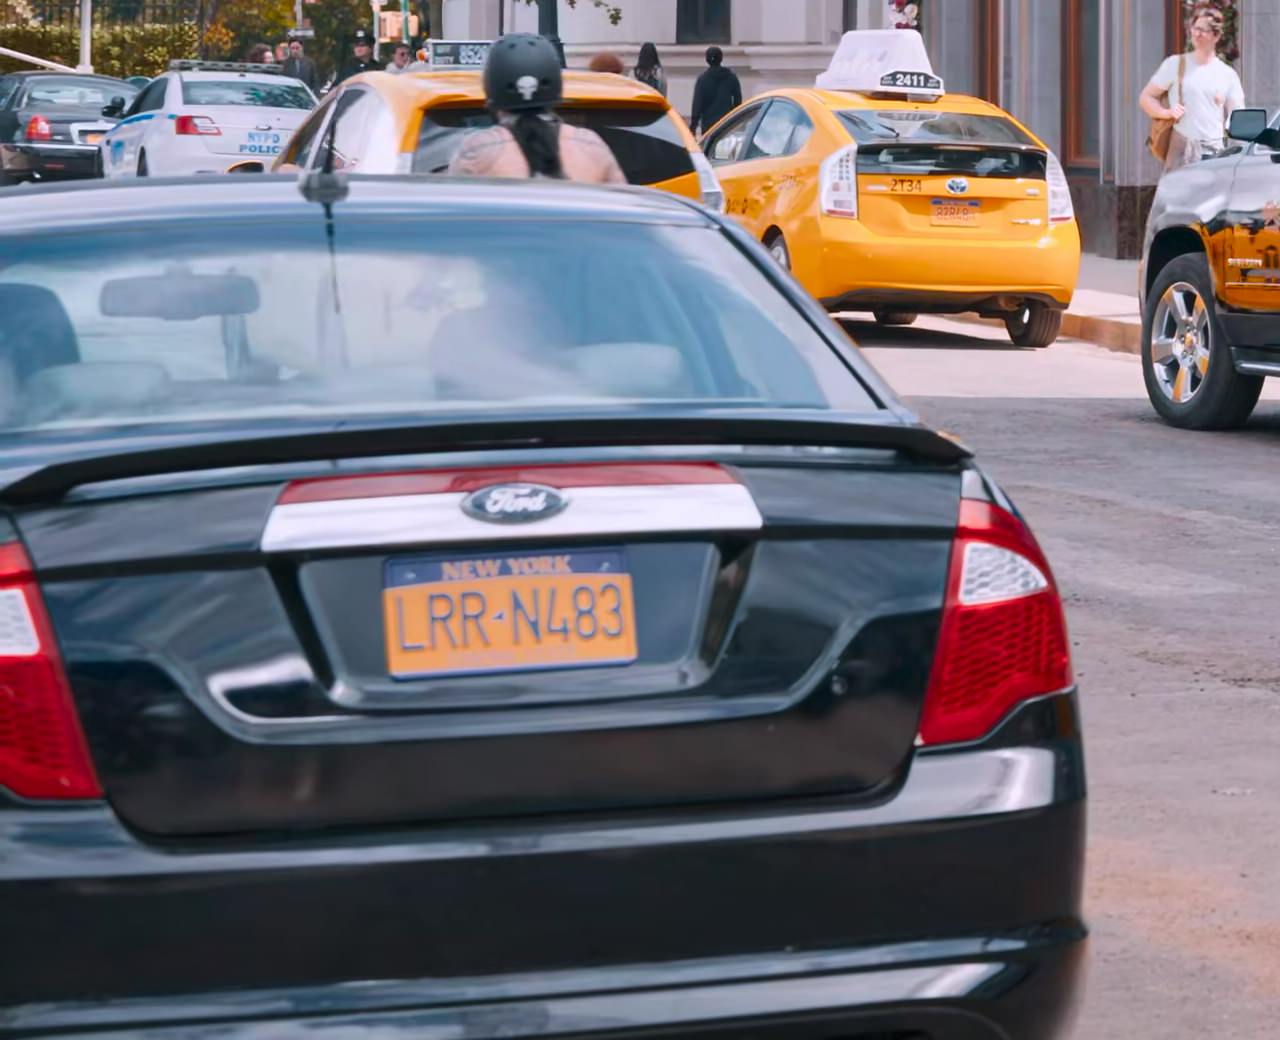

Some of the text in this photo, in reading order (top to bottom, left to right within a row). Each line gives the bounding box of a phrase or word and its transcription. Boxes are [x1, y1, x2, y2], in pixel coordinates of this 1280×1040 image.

[896, 74, 924, 87] 2411
[248, 132, 280, 144] NYPD
[239, 144, 282, 154] POLIC
[890, 179, 922, 192] 2T34
[485, 488, 547, 513] Ford
[441, 555, 572, 581] NEW YORK
